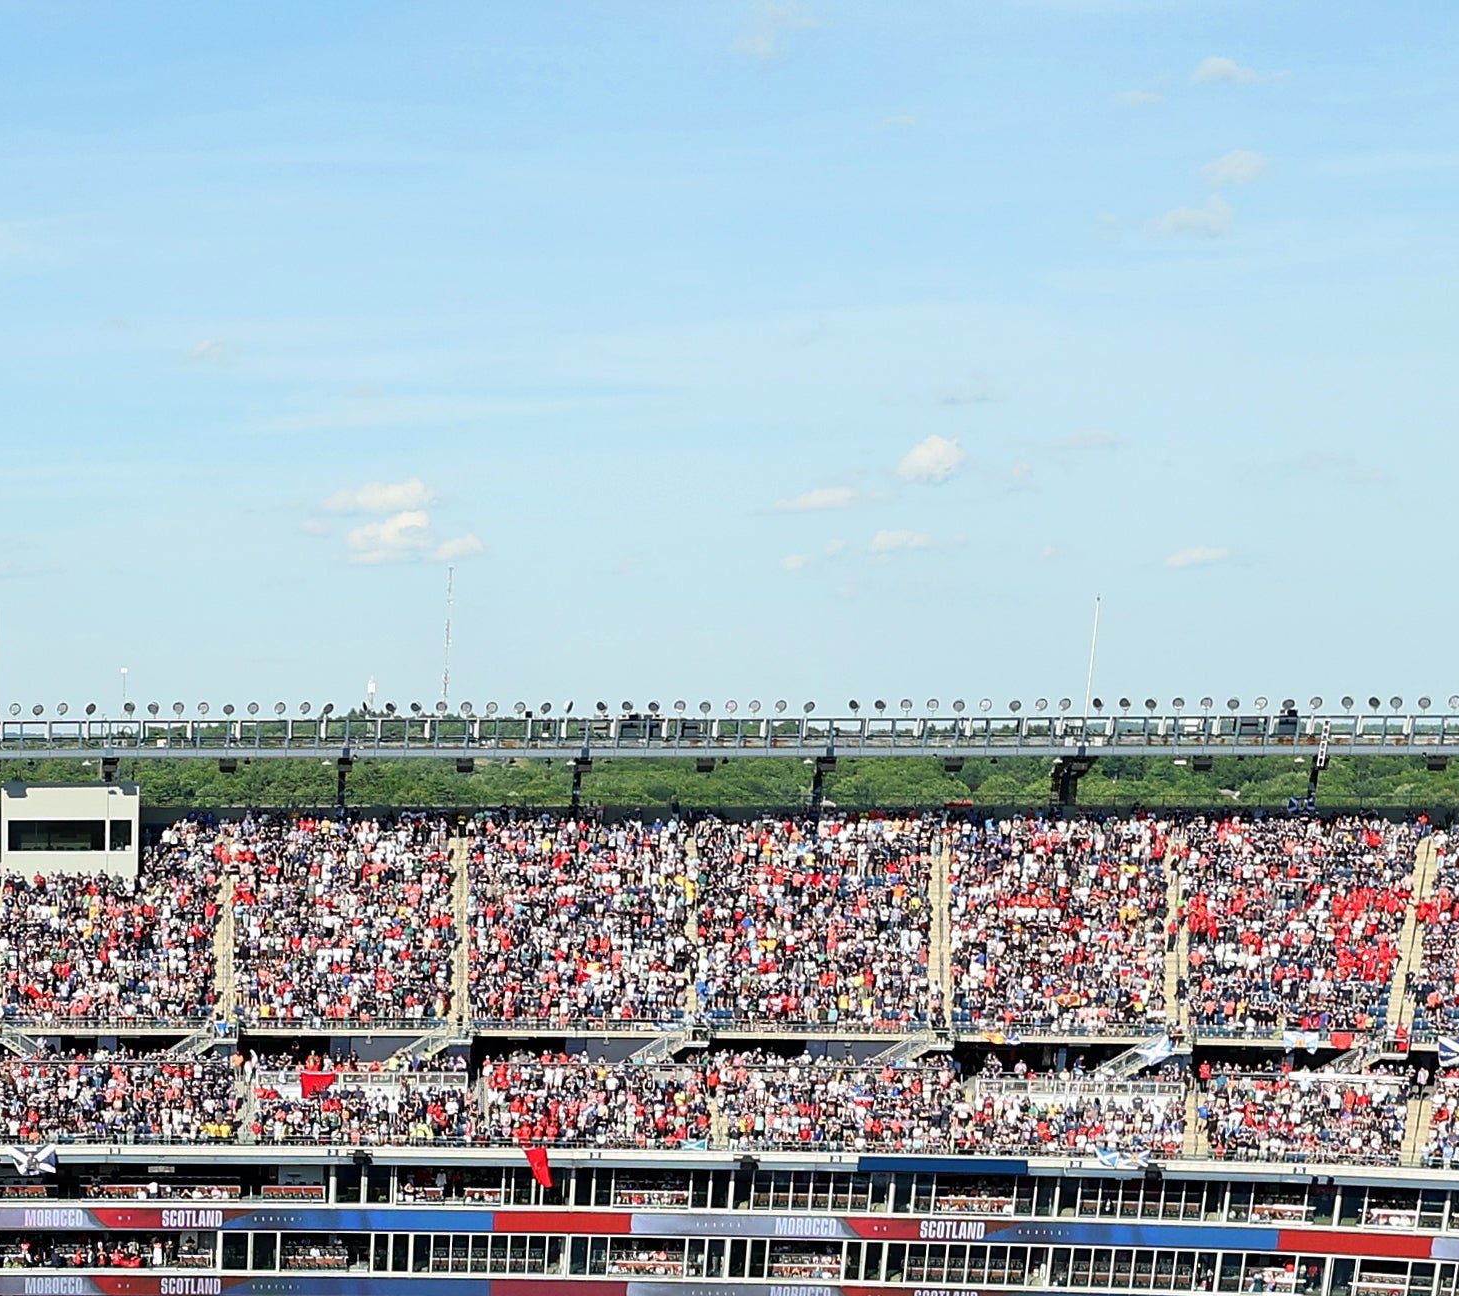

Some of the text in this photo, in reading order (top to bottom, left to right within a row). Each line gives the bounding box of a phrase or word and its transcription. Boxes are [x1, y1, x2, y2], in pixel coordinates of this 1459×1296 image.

[24, 1209, 224, 1228] MOROCCO SCOTLAND
[775, 1217, 986, 1240] MOROCCO SCOTLAND
[24, 1276, 221, 1296] MOROCCO SCOTLAND
